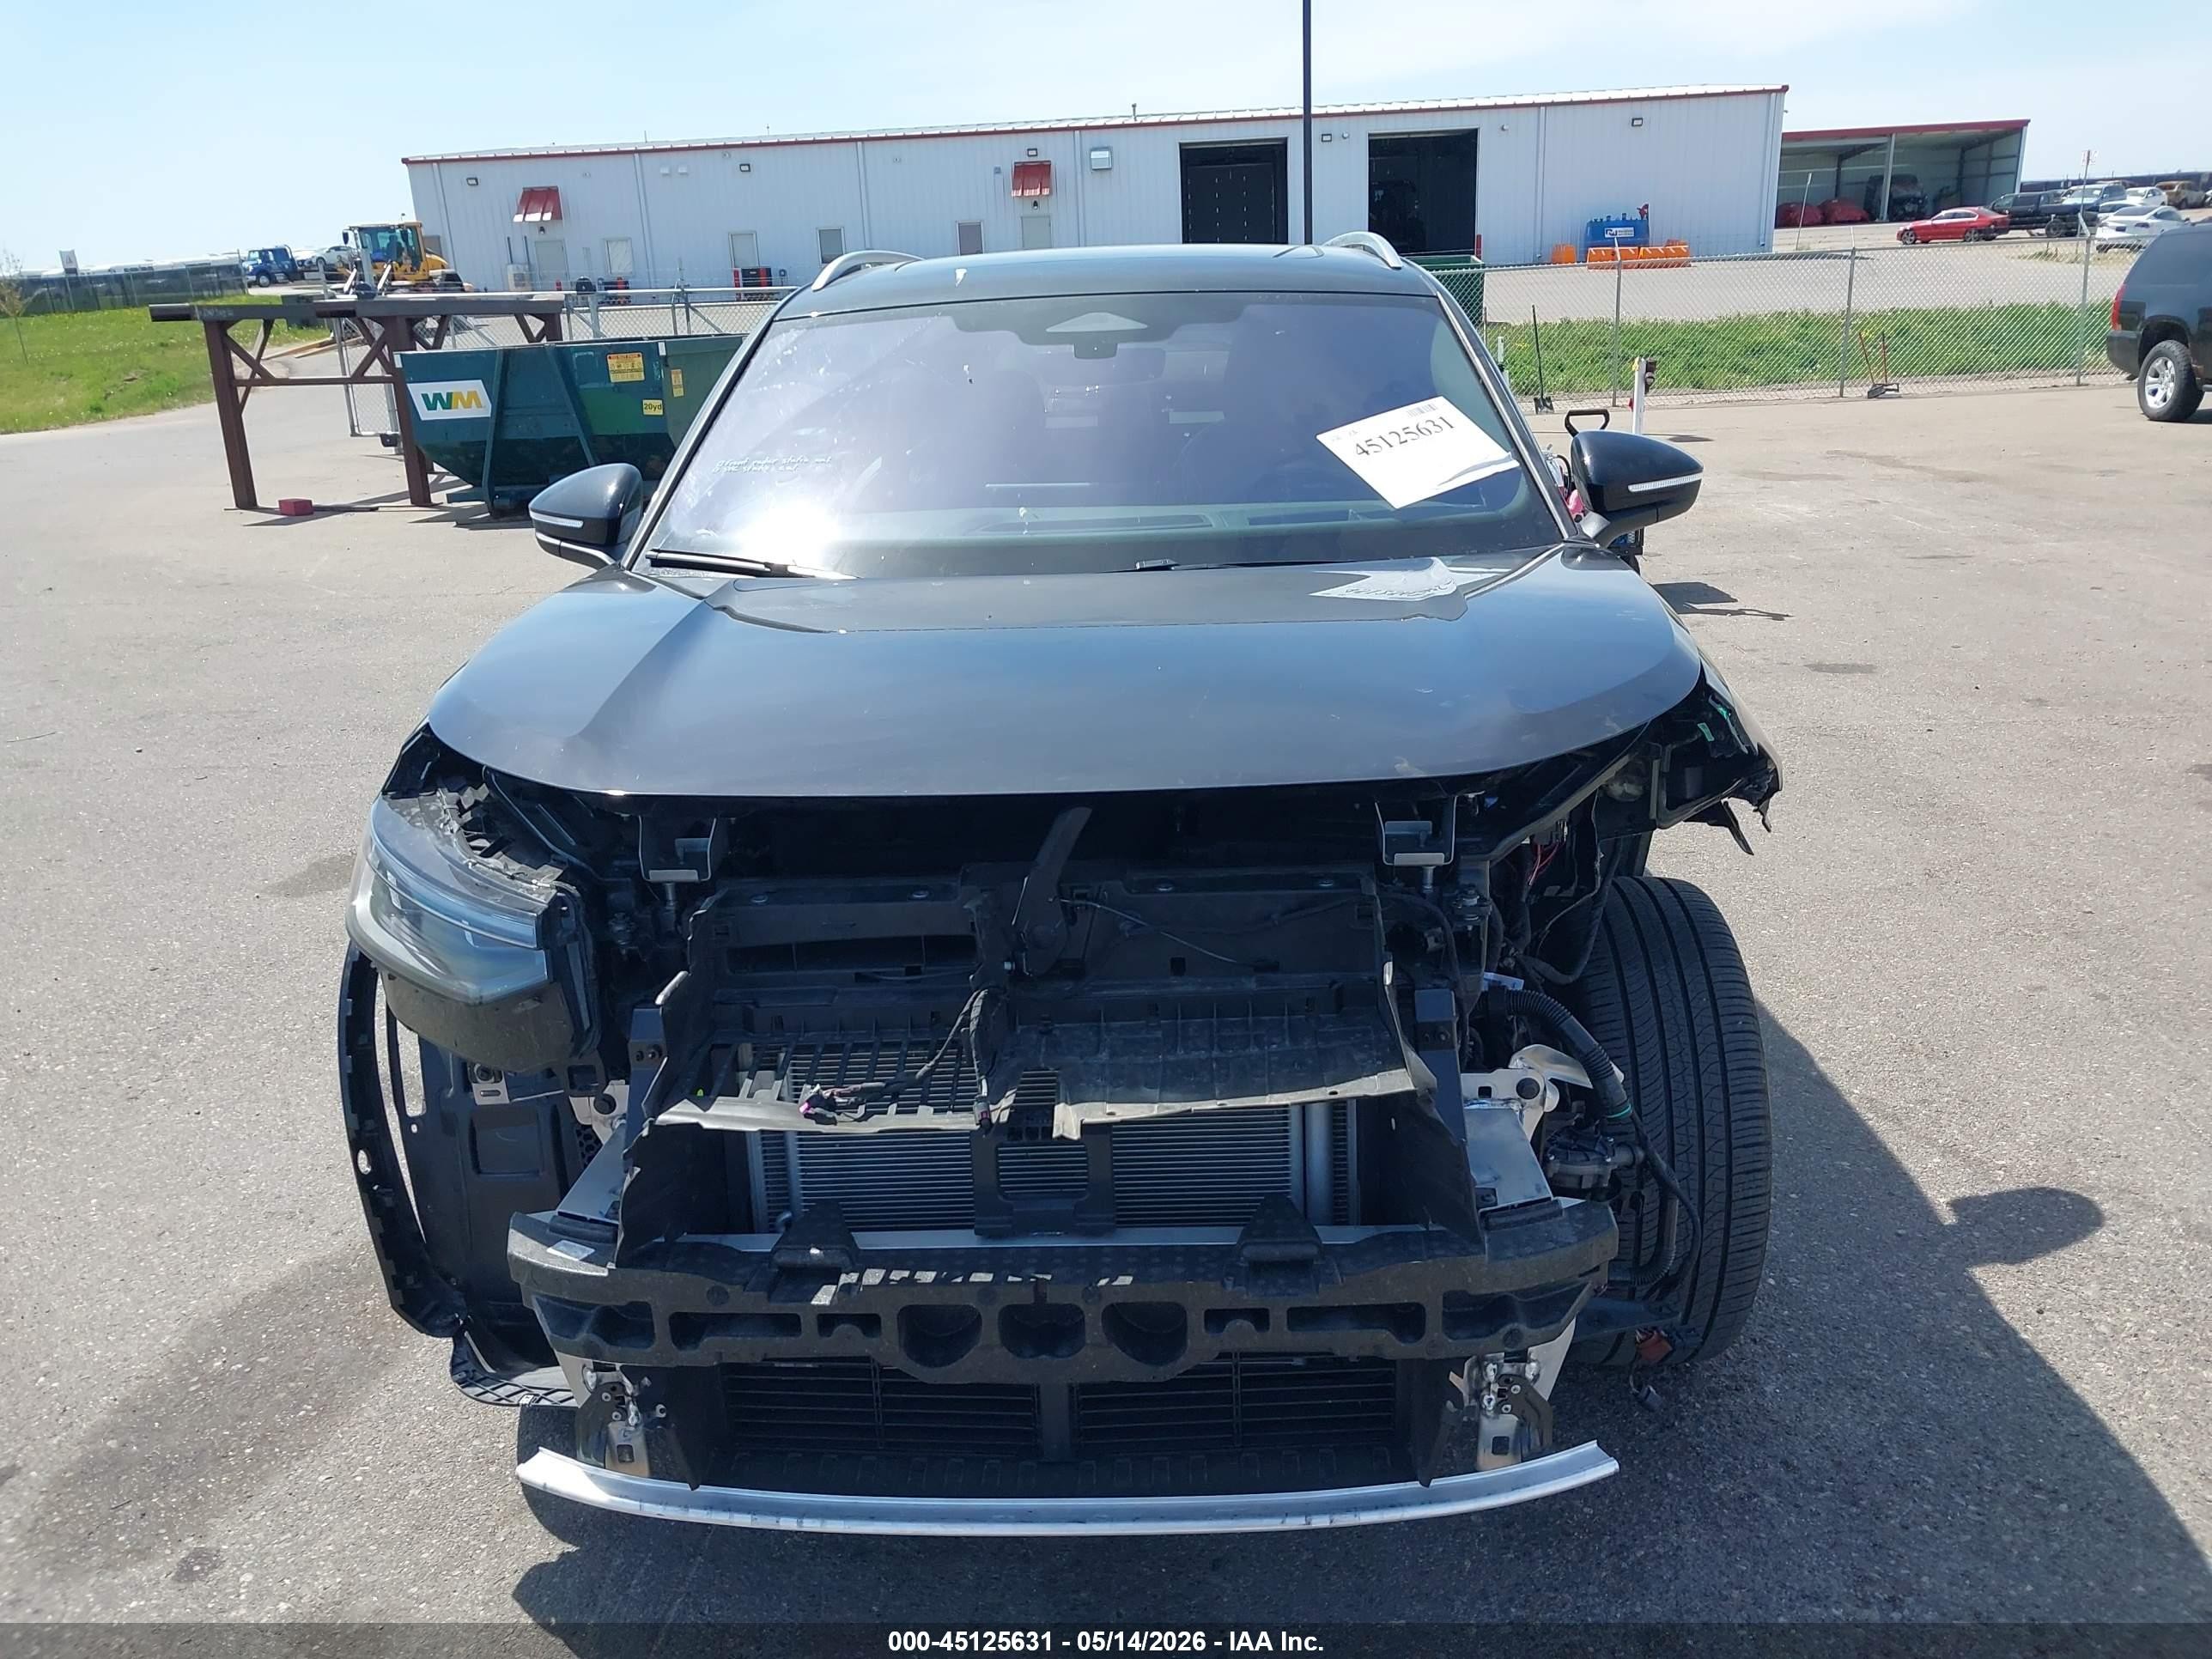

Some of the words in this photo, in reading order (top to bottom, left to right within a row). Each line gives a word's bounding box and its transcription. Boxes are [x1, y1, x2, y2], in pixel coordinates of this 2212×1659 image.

[421, 391, 483, 411] WM
[643, 403, 662, 412] 20yd
[1356, 416, 1455, 455] 45125631
